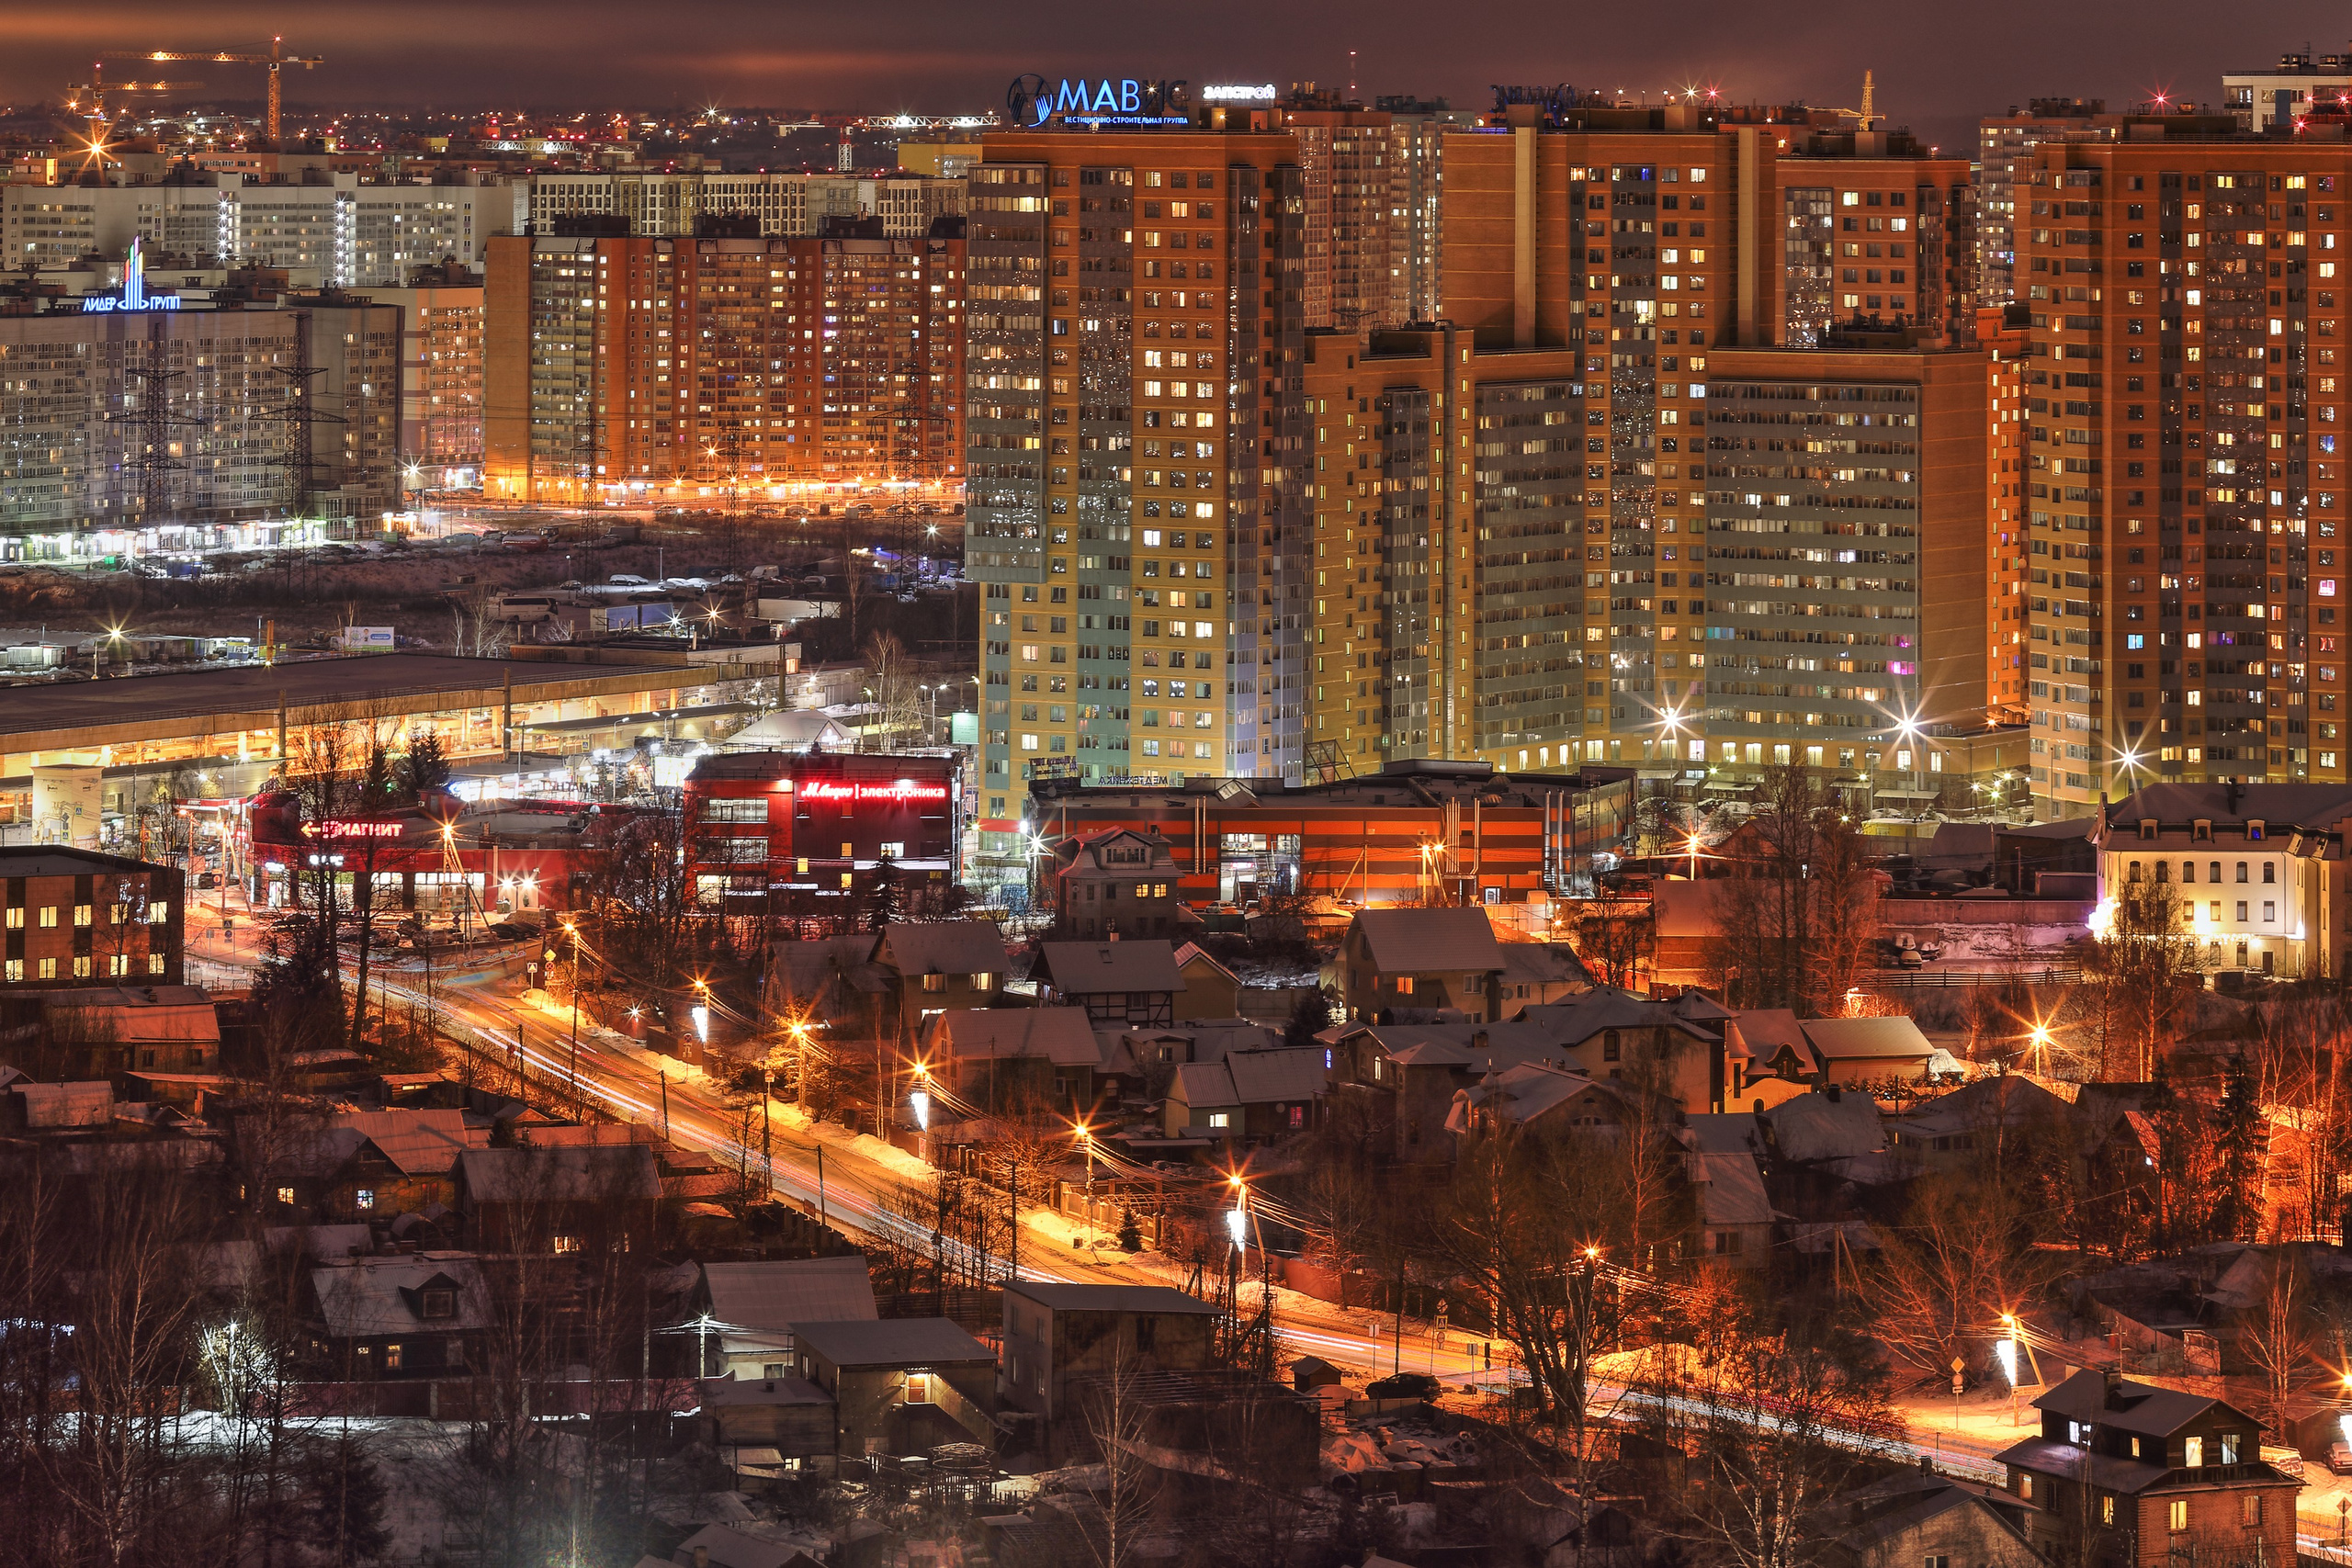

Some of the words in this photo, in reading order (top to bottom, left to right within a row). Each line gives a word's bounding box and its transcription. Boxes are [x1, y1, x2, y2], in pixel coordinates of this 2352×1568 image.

[1203, 85, 1276, 99] ЗАПСТРОЙ
[83, 298, 116, 311] ЛИДЕР
[150, 296, 180, 310] ГРУПП
[860, 788, 945, 801] электроника
[338, 822, 402, 837] МАГНИТ
